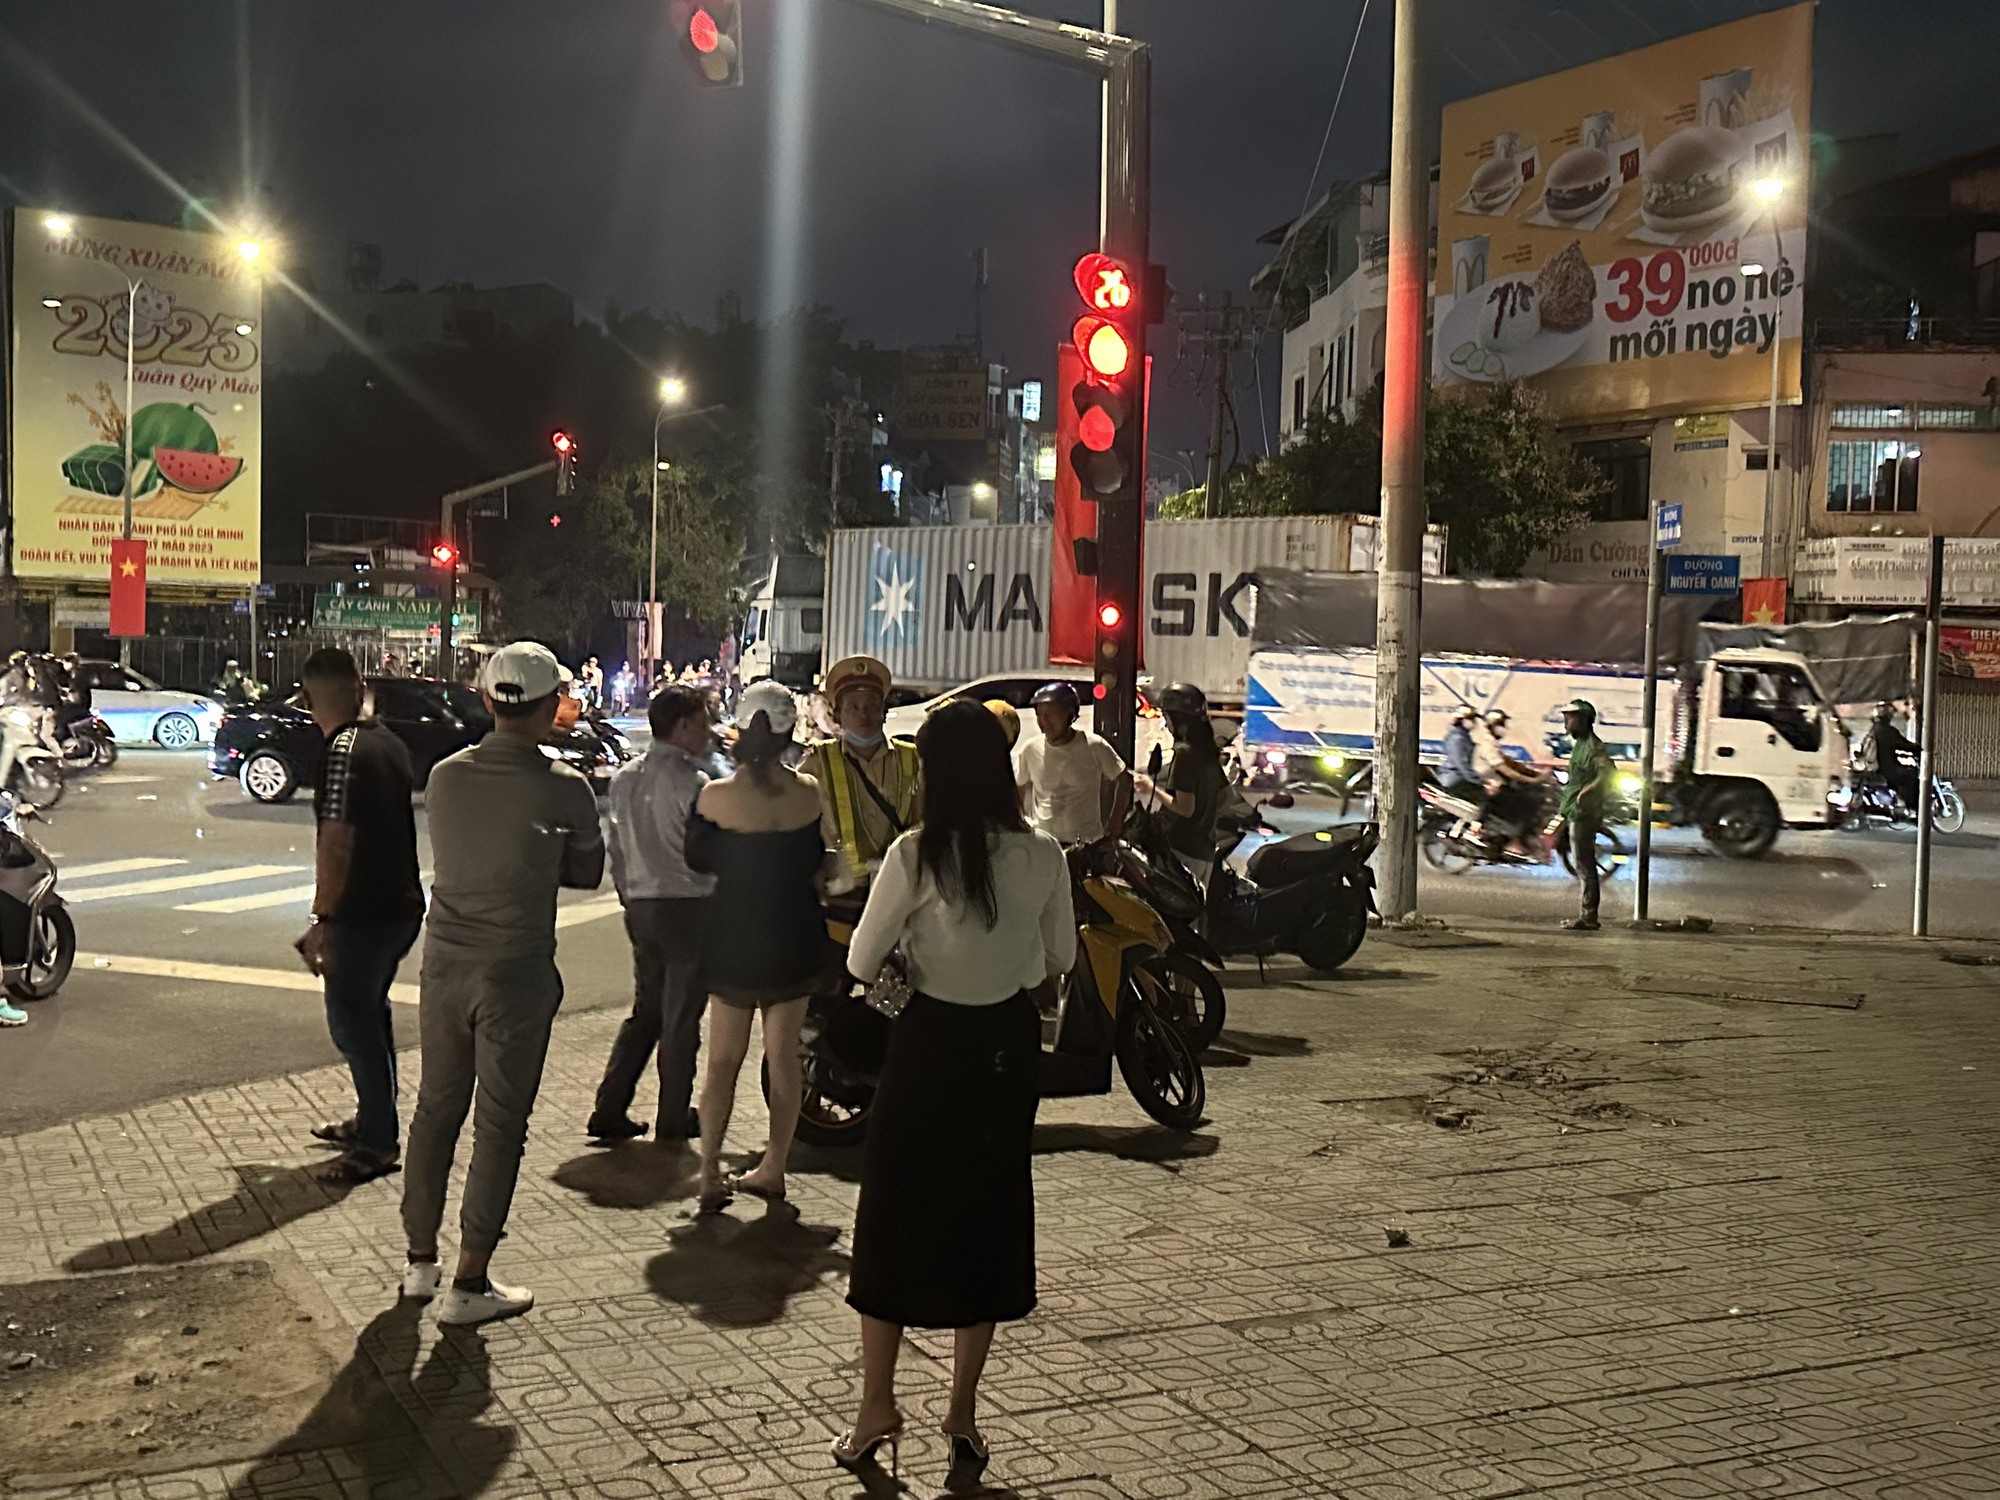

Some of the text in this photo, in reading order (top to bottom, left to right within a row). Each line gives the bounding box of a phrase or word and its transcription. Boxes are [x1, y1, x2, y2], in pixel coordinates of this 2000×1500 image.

[1687, 276, 1736, 310] no
[1745, 256, 1795, 302] nê
[53, 295, 258, 372] 2023
[1609, 307, 1782, 363] mỗi ngày
[58, 518, 90, 531] NHÂN
[156, 523, 176, 537] PHỐ
[217, 529, 244, 540] MINH
[80, 552, 97, 564] VUI
[194, 557, 208, 569] VÀ
[1589, 539, 1650, 567] Cường
[1684, 559, 1723, 571] ĐƯỜNG
[1670, 572, 1737, 589] NGUYỄN OANH
[396, 601, 431, 614] NAM
[944, 572, 1257, 638] MASK
